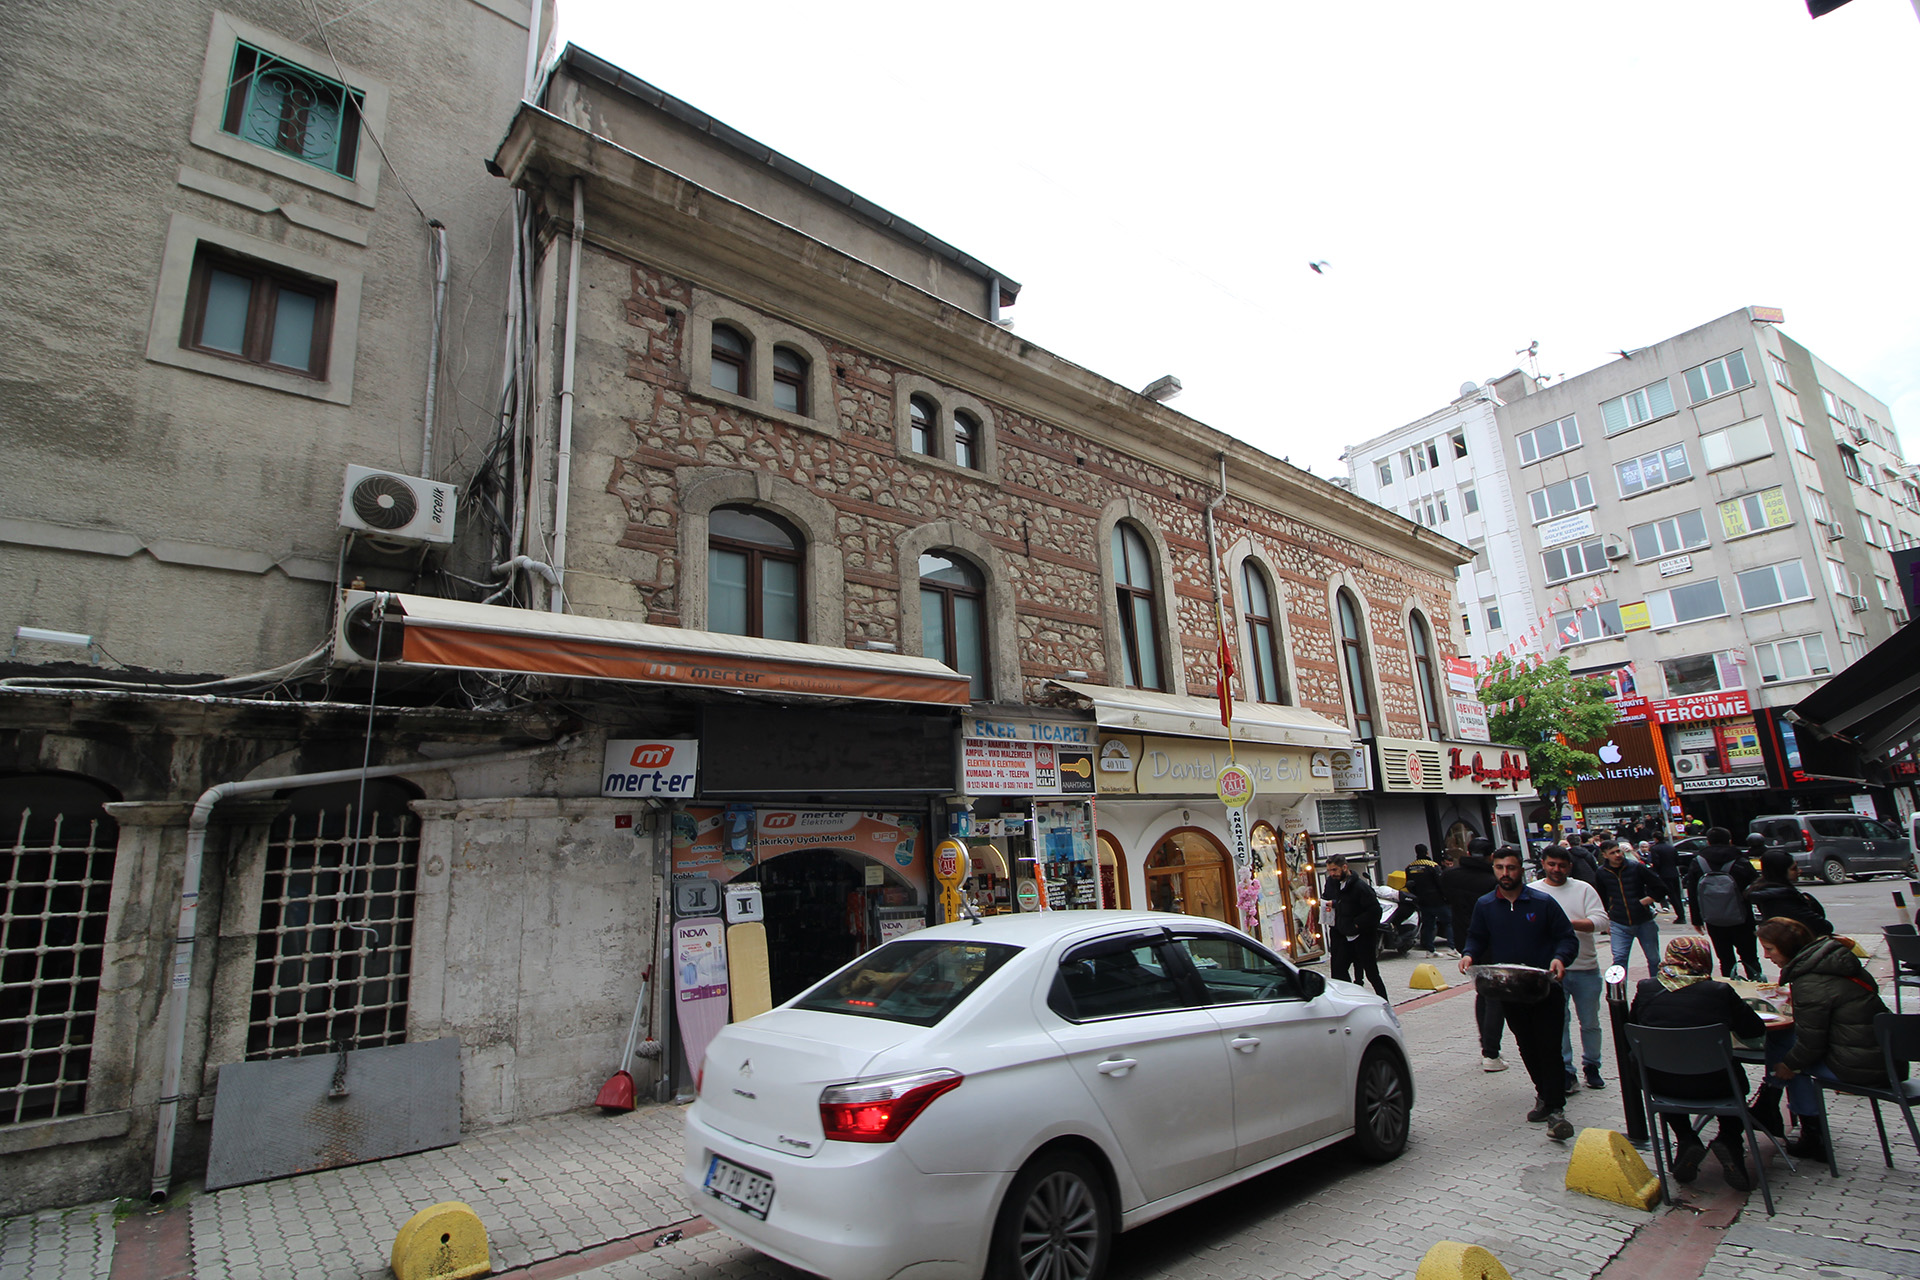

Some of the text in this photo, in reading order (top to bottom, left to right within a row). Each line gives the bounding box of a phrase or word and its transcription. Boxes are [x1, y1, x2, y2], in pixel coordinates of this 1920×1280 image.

[432, 487, 445, 524] arçelik
[1724, 503, 1737, 514] SA
[690, 667, 765, 684] merter
[1654, 700, 1748, 723] TERCÜME
[975, 720, 1088, 742] EKER TİCARET
[966, 749, 984, 757] AMPUL
[1001, 751, 1033, 759] MALZEMELER
[967, 758, 991, 767] ELEKTRİK
[997, 759, 1026, 768] ELEKTRONİK
[1106, 761, 1126, 769] 40 YIL
[1150, 751, 1216, 779] Dantel
[1276, 757, 1303, 780] Evi
[966, 770, 992, 778] KUMANDA
[997, 769, 1005, 777] PİL
[1009, 770, 1030, 778] TELEFON
[1037, 769, 1054, 777] KALE
[1606, 765, 1655, 779] İLETİŞİM
[605, 770, 694, 792] mert-er
[1037, 778, 1055, 786] KİLİT
[1062, 781, 1092, 789] ANAHTARCI
[1219, 776, 1247, 795] KALE
[1685, 777, 1758, 788] HAMURCU PASAJI
[802, 811, 848, 819] merter
[797, 835, 820, 845] Uydu
[821, 834, 856, 843] Merkezi
